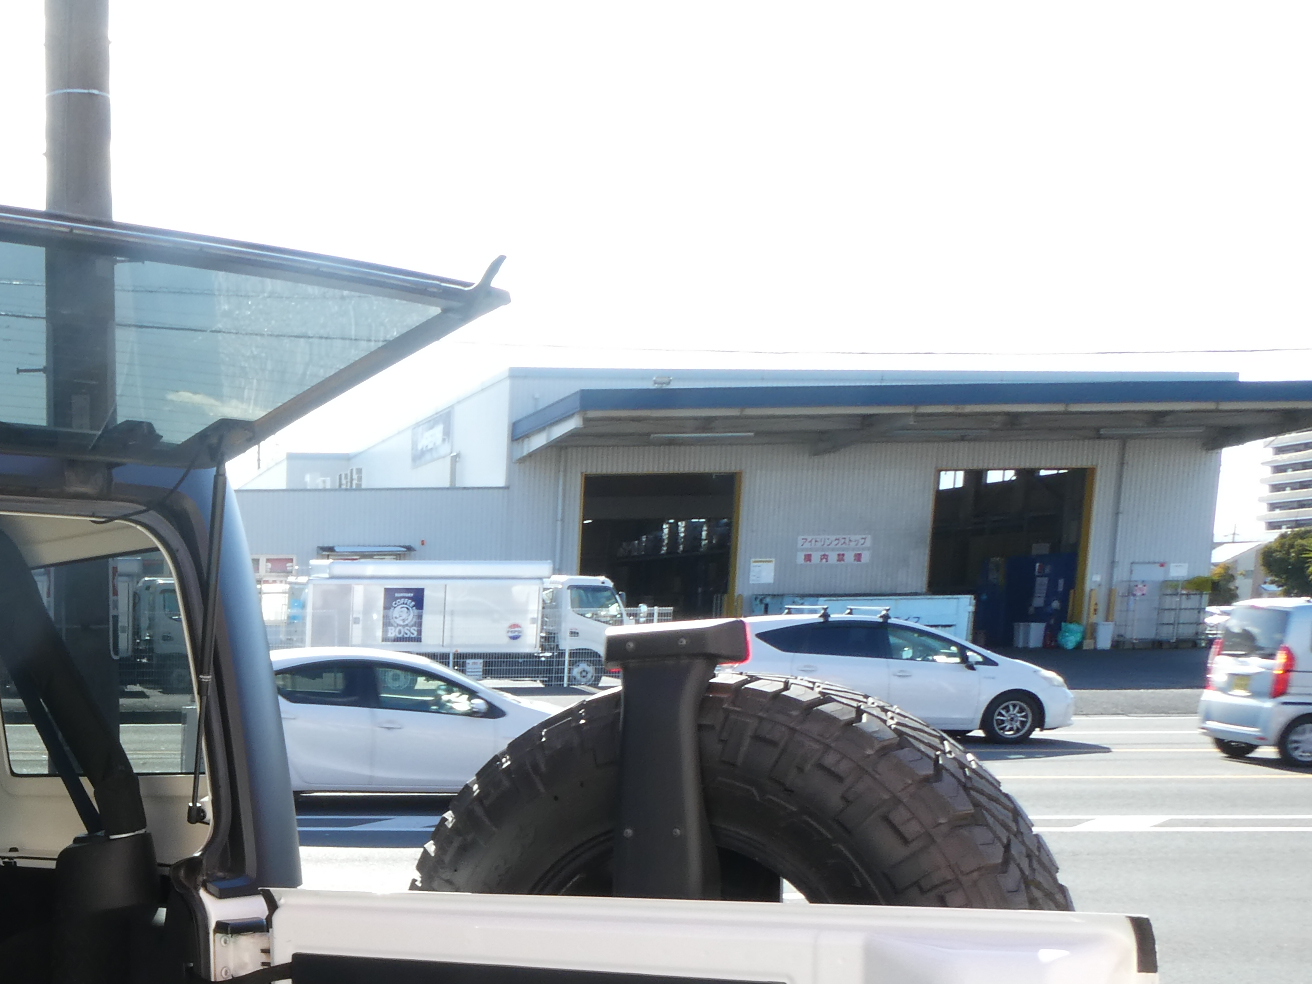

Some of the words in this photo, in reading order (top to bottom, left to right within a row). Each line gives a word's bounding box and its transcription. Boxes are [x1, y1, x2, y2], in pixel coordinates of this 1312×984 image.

[800, 536, 867, 547] アイドリングストップ
[392, 598, 415, 608] COFFEE
[388, 626, 417, 638] BOSS
